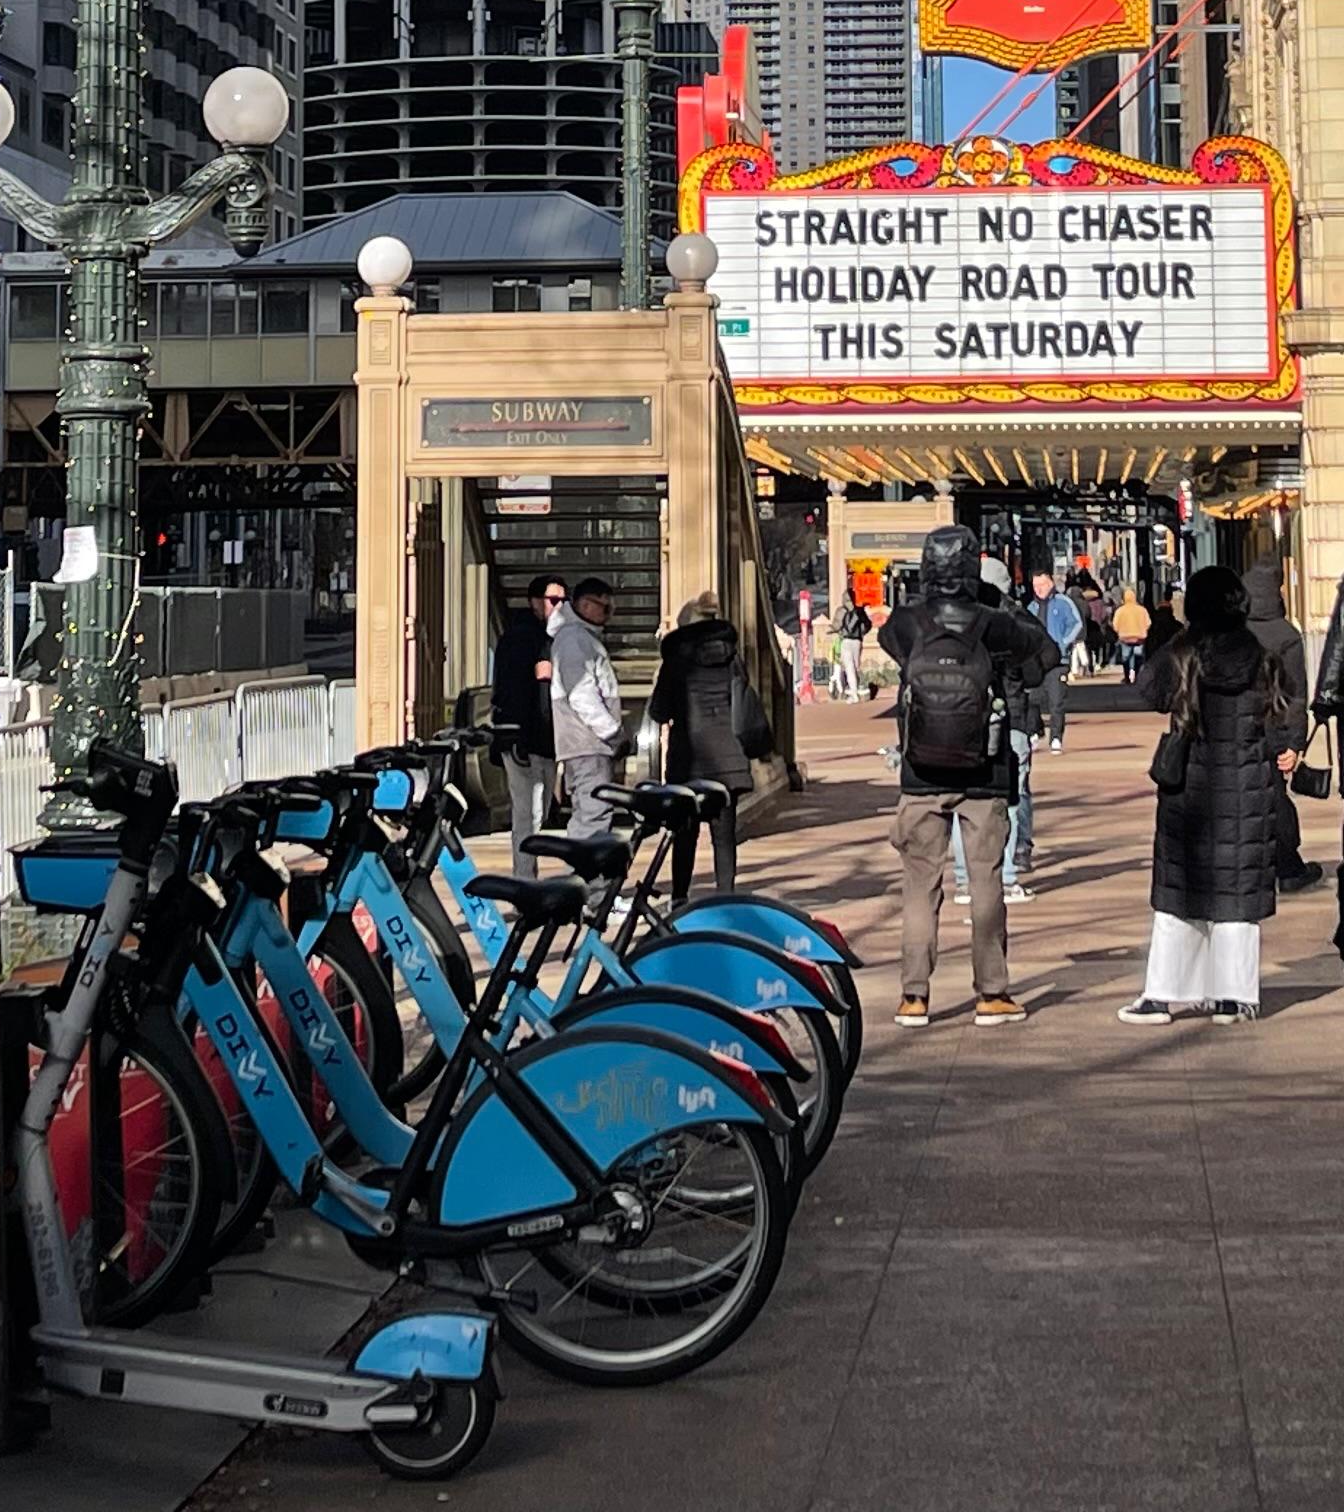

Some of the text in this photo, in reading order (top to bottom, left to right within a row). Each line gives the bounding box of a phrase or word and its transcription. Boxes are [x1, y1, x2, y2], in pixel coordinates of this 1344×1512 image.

[754, 204, 1214, 247] STRAIGHT NO CHASER
[773, 261, 1196, 304] HOLIDAY ROAD TOUR
[814, 319, 1144, 361] THIS SATURDAY
[491, 400, 584, 423] SUBWAY
